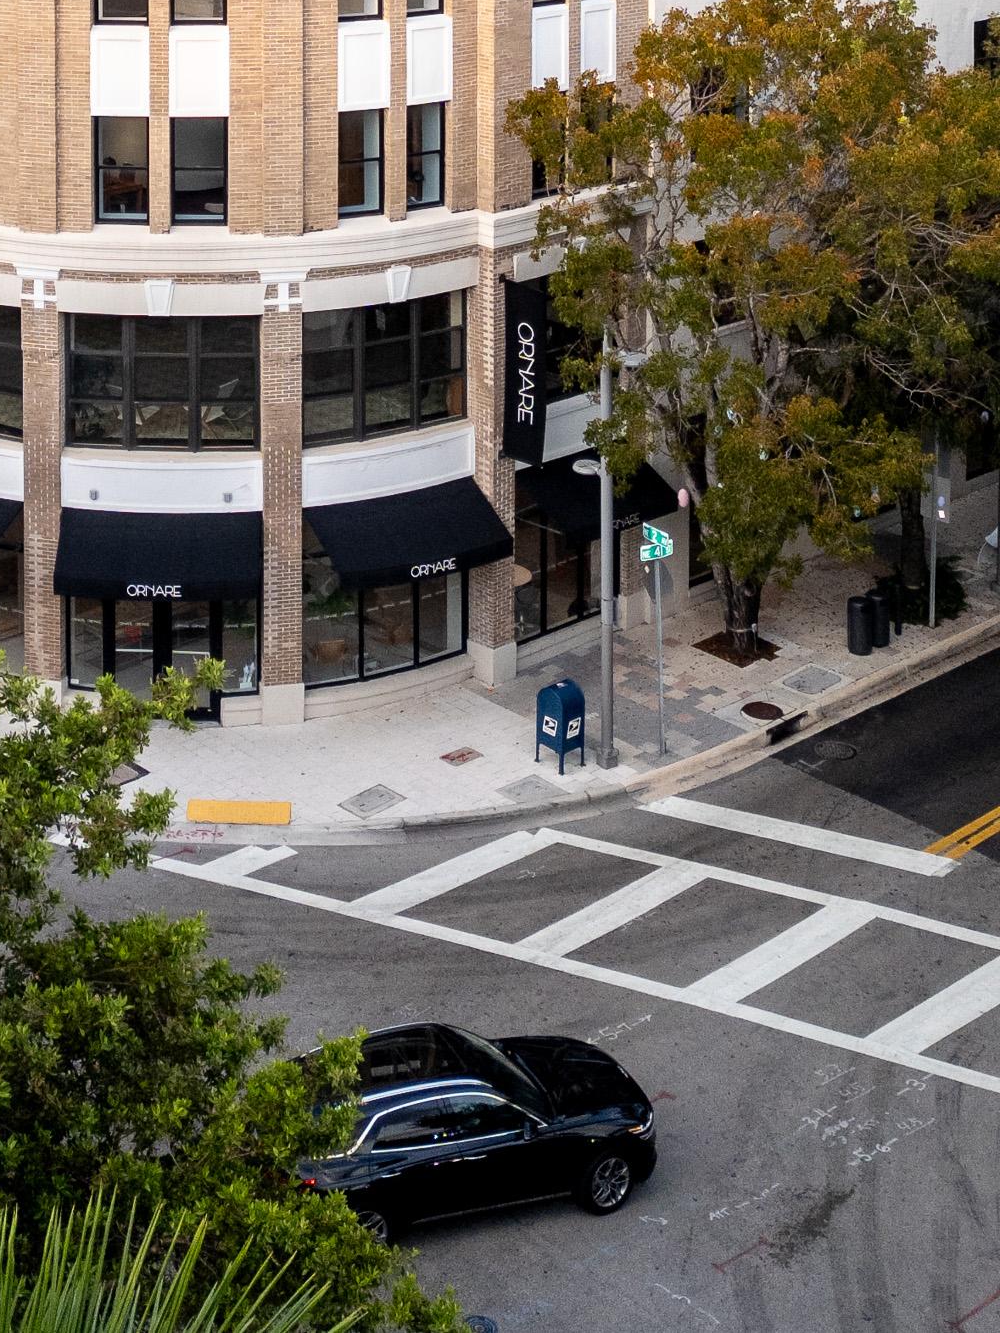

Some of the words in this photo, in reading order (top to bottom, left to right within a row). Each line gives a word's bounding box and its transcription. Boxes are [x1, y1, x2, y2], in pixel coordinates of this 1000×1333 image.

[517, 322, 535, 425] ORNARE
[652, 530, 658, 542] 2
[641, 549, 650, 559] NE
[410, 557, 456, 578] ORNARE
[126, 584, 182, 597] ORNARE
